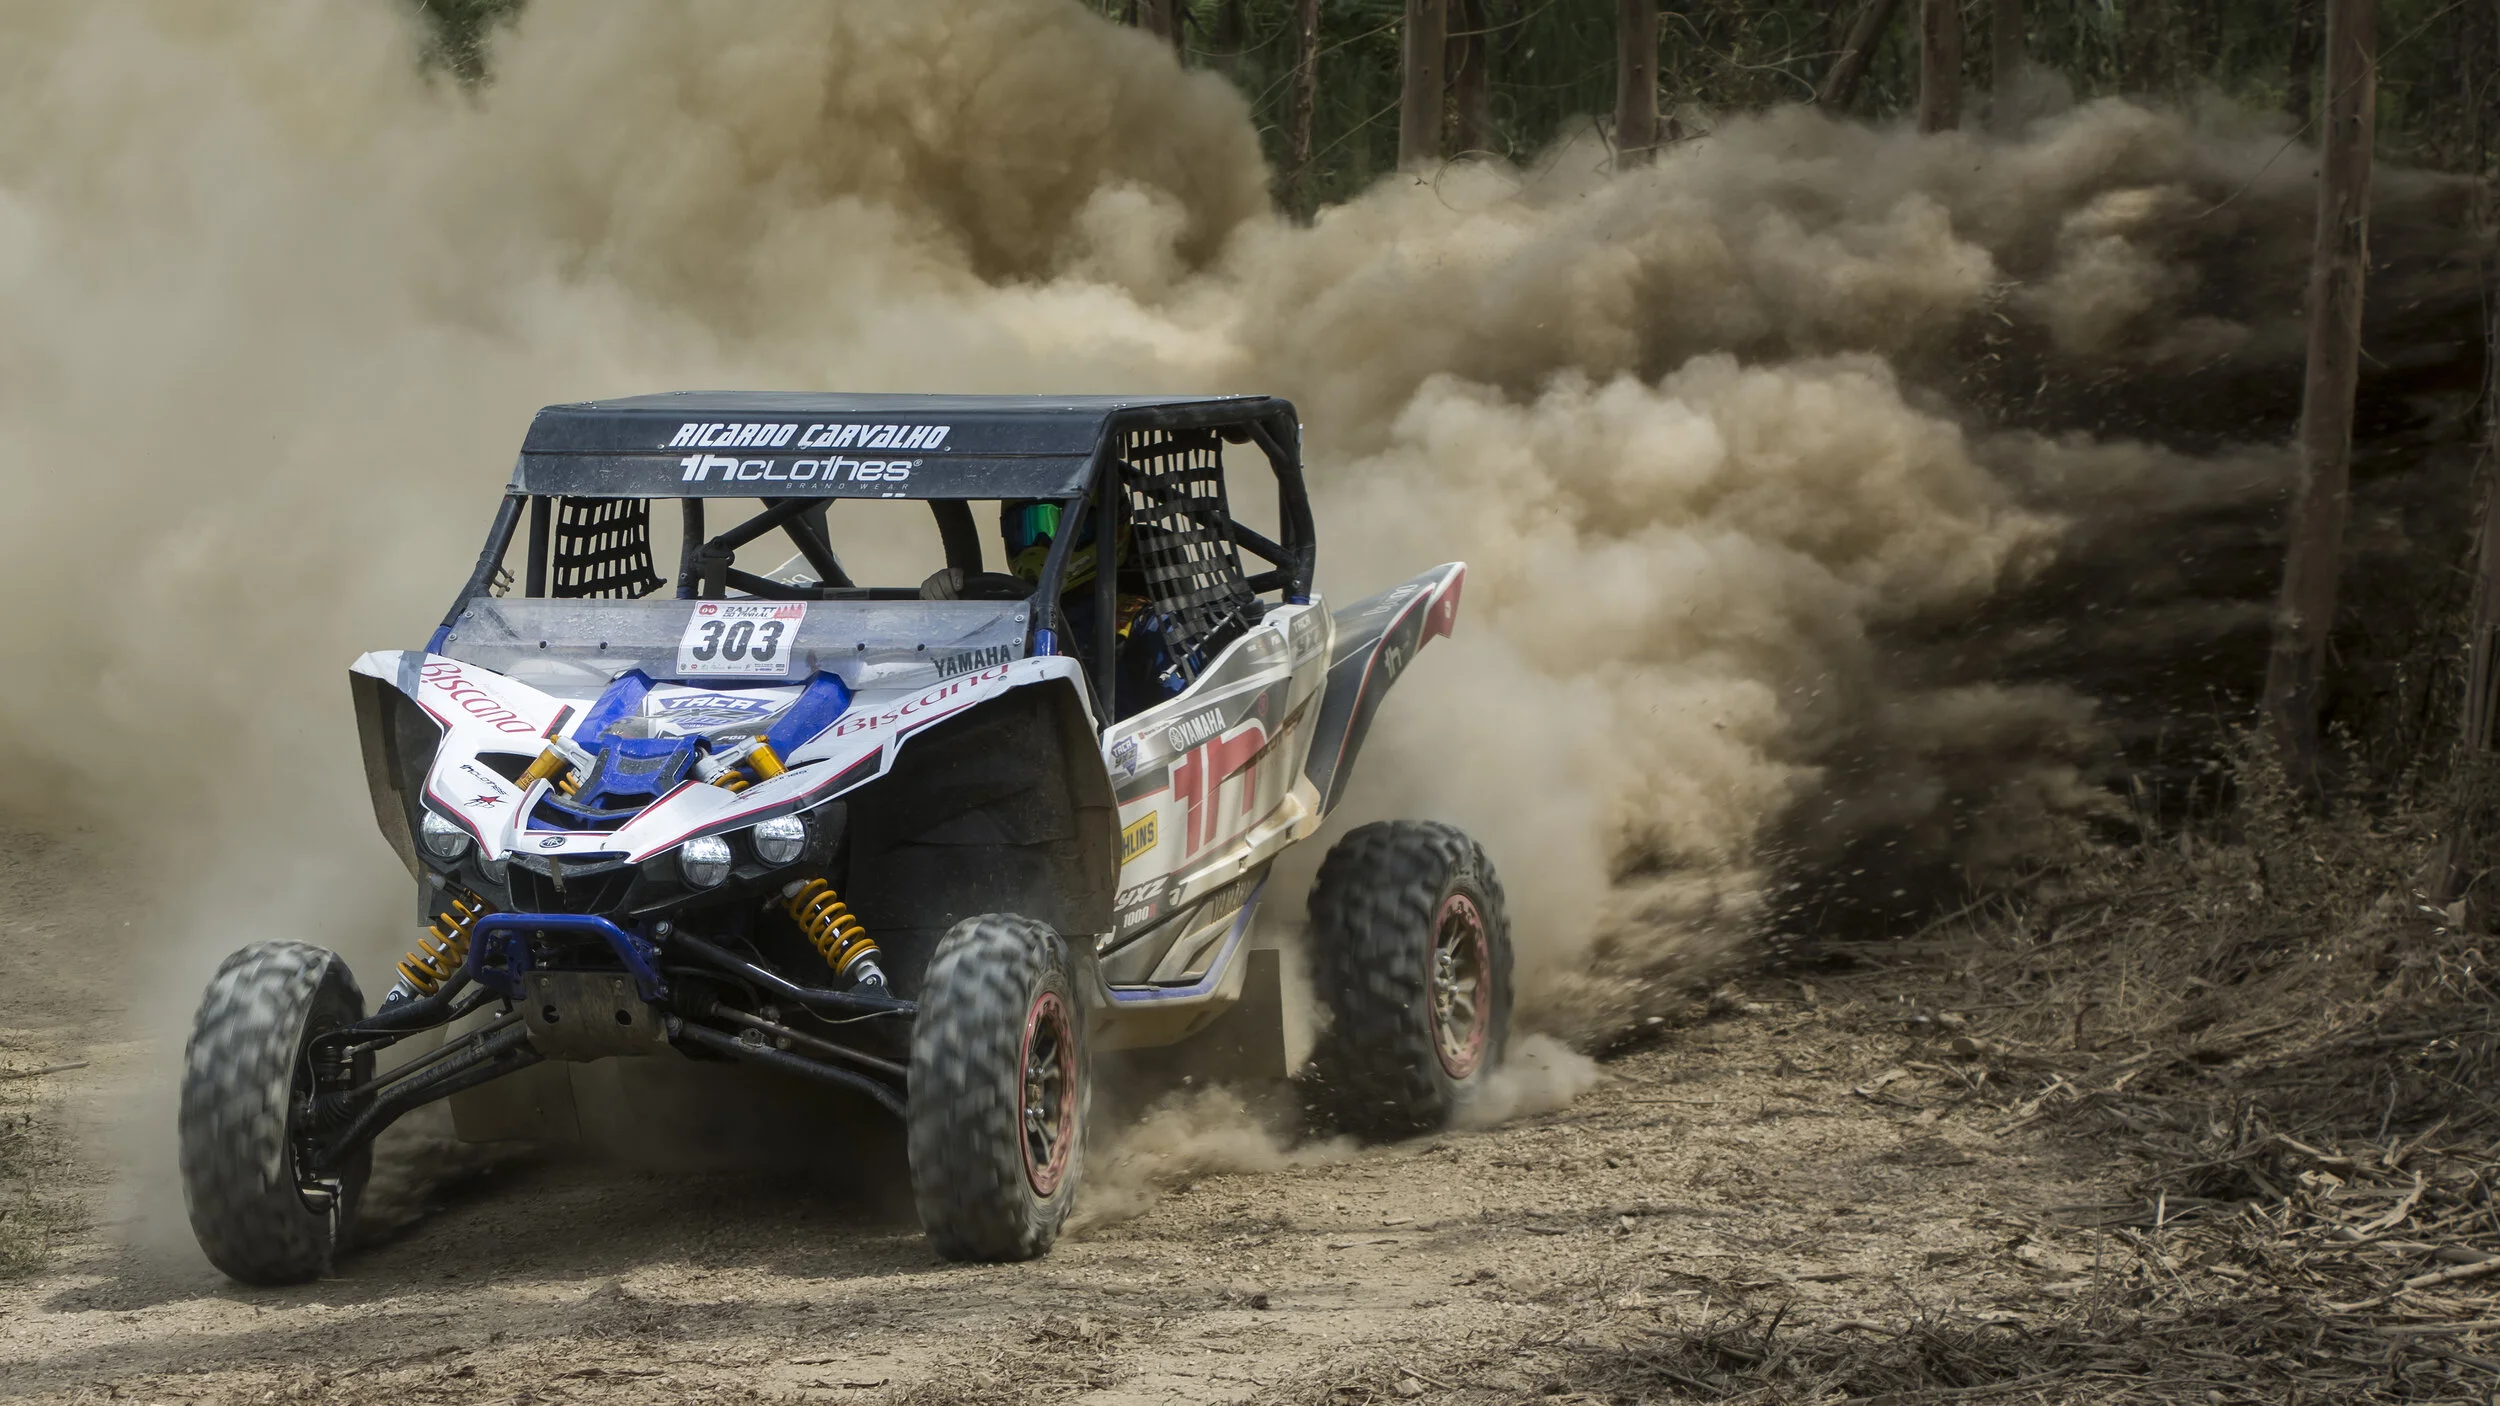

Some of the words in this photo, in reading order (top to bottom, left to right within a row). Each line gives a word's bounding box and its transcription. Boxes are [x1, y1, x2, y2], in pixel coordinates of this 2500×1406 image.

[669, 423, 798, 448] RICARDO
[798, 424, 951, 450] CARVALHO
[786, 482, 845, 490] BRAND
[859, 483, 909, 491] WEAR
[692, 620, 785, 662] 303
[930, 644, 1012, 678] YAMAHA
[668, 697, 758, 709] TACA
[1179, 707, 1226, 746] YAMAHA
[1112, 741, 1133, 757] TACA
[1121, 820, 1154, 859] HLINS
[1113, 876, 1169, 912] YXZ
